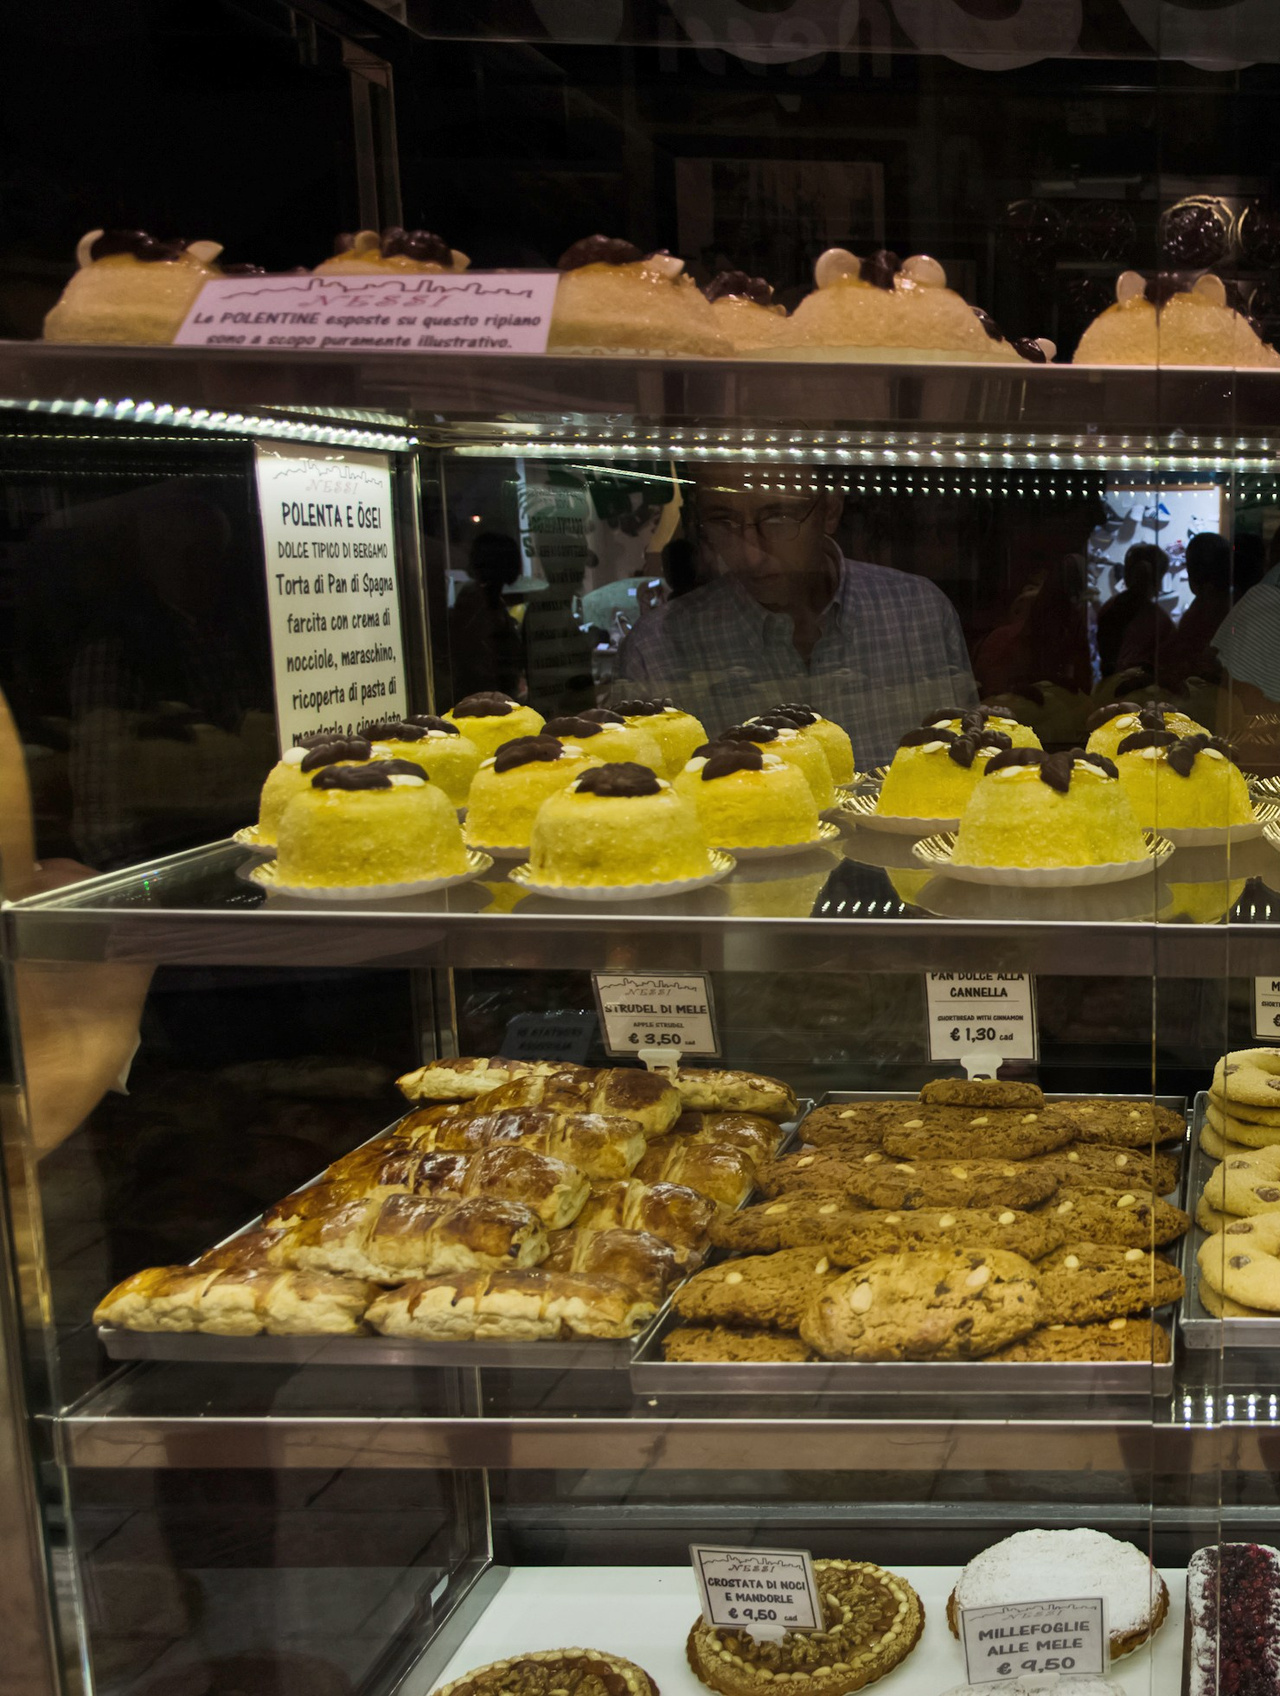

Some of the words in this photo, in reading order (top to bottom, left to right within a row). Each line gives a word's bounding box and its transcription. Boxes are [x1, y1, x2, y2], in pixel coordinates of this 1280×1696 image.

[298, 295, 451, 307] NESSI
[193, 312, 214, 324] Le
[220, 312, 320, 324] POLENTINE
[325, 314, 390, 328] esposte
[397, 315, 417, 326] su
[422, 314, 479, 329] questo
[484, 314, 541, 329] ripiano
[206, 335, 246, 344] sono
[251, 335, 261, 344] a
[267, 335, 316, 347] scopo
[319, 336, 411, 348] puramente
[418, 335, 512, 348] illustrativo.
[282, 501, 343, 527] POLENTA
[346, 505, 354, 528] E
[278, 541, 309, 559] DOLCE
[312, 542, 340, 559] TIPICO
[342, 542, 351, 559] DI
[353, 542, 388, 559] BERGAMO
[275, 573, 310, 595] Torta
[314, 574, 324, 595] di
[328, 573, 347, 594] Pan
[351, 573, 360, 593] di
[363, 572, 394, 598] Spagna
[287, 612, 327, 634] farcita
[331, 615, 349, 631] con
[352, 612, 380, 629] crema
[383, 607, 391, 626] di
[287, 648, 338, 673] nocciole,
[341, 642, 396, 667] maraschino,
[292, 685, 345, 713] ricoperta
[348, 682, 358, 702] di
[361, 679, 386, 706] pasta
[388, 676, 397, 695] di
[346, 723, 353, 737] e
[931, 972, 954, 980] PAN
[958, 972, 993, 980] DOLCE
[997, 972, 1024, 980] ALLA
[950, 987, 1008, 997] CANNELLA
[604, 1004, 657, 1014] STRUDEL
[661, 1005, 672, 1014] DI
[676, 1005, 707, 1014] MELE
[628, 1032, 639, 1044] €
[644, 1033, 681, 1046] 3,50
[950, 1028, 960, 1041] €
[965, 1027, 996, 1043] 1,30
[708, 1577, 764, 1590] CROSTATA
[767, 1580, 777, 1589] DI
[780, 1581, 806, 1591] NOCI
[725, 1592, 732, 1601] E
[735, 1593, 794, 1604] MANDORLE
[728, 1607, 739, 1619] €
[742, 1608, 777, 1622] 9,50
[978, 1620, 1090, 1642] MILLEFOGLIE
[987, 1642, 1029, 1657] ALLE
[1036, 1638, 1083, 1651] MELE
[996, 1662, 1012, 1675] €
[1020, 1656, 1076, 1673] 9,50
